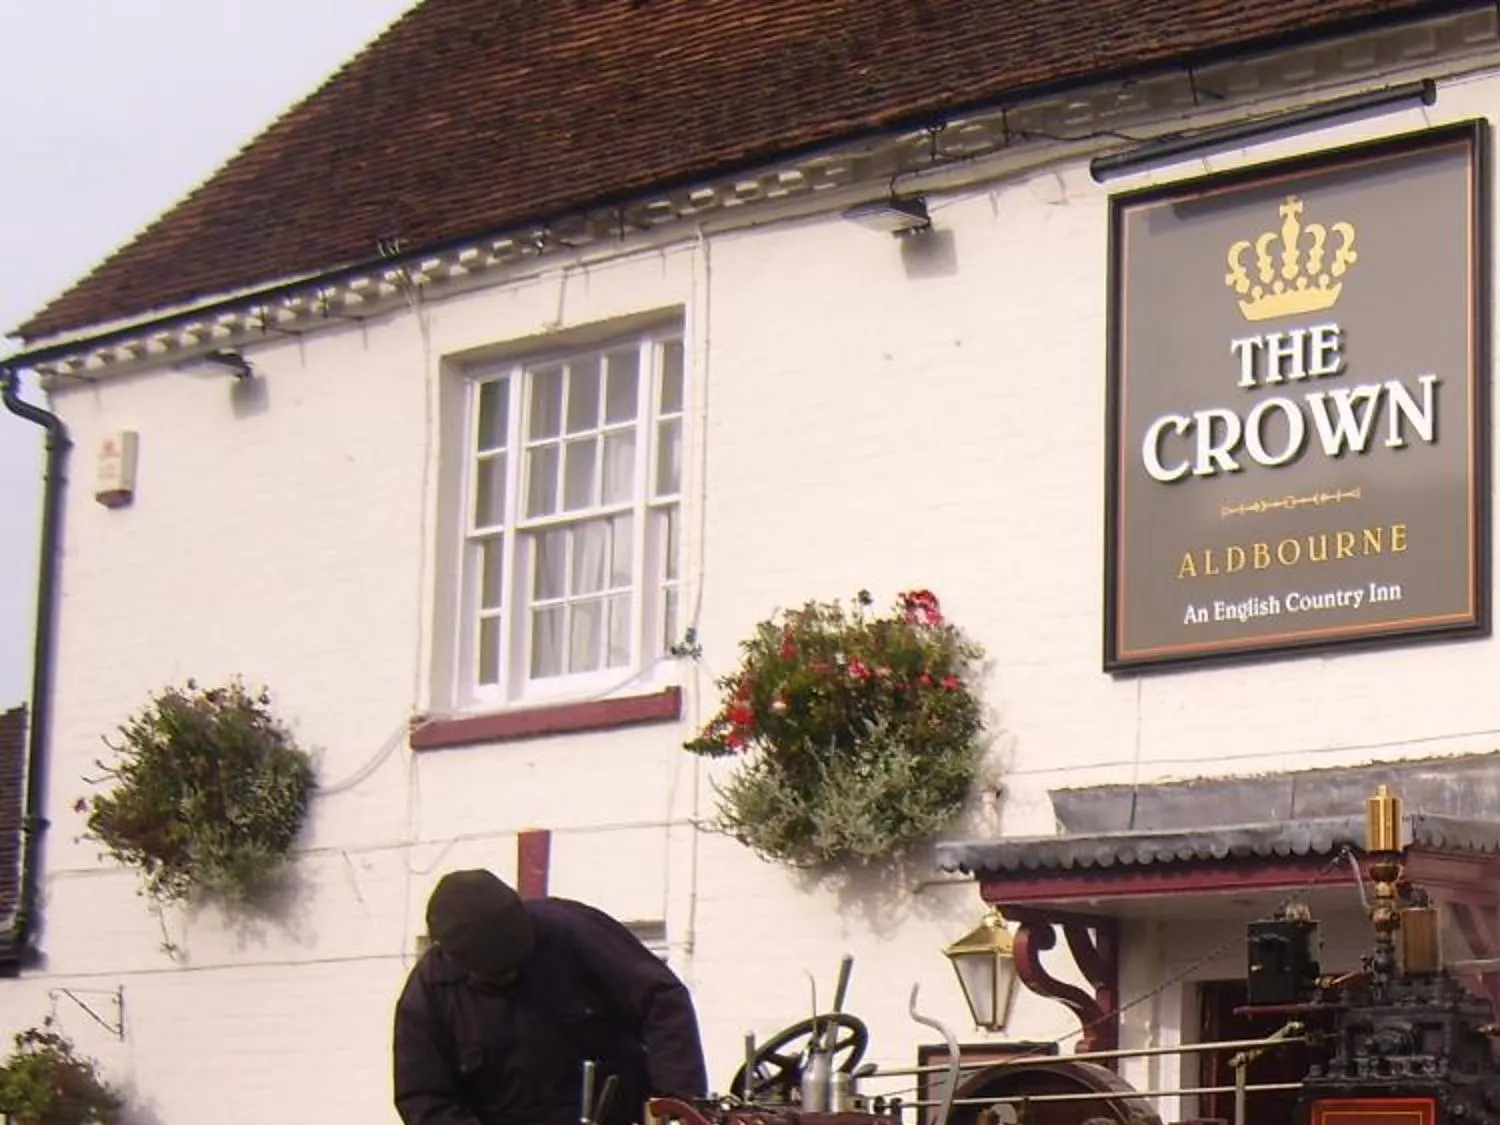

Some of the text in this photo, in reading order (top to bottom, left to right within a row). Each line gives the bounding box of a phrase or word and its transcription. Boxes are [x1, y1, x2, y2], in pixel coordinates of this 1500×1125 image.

[1231, 323, 1342, 388] THE
[1142, 374, 1438, 482] CROWN
[1177, 523, 1408, 579] ALDBOURNE
[1184, 582, 1402, 625] An English Country Inn
